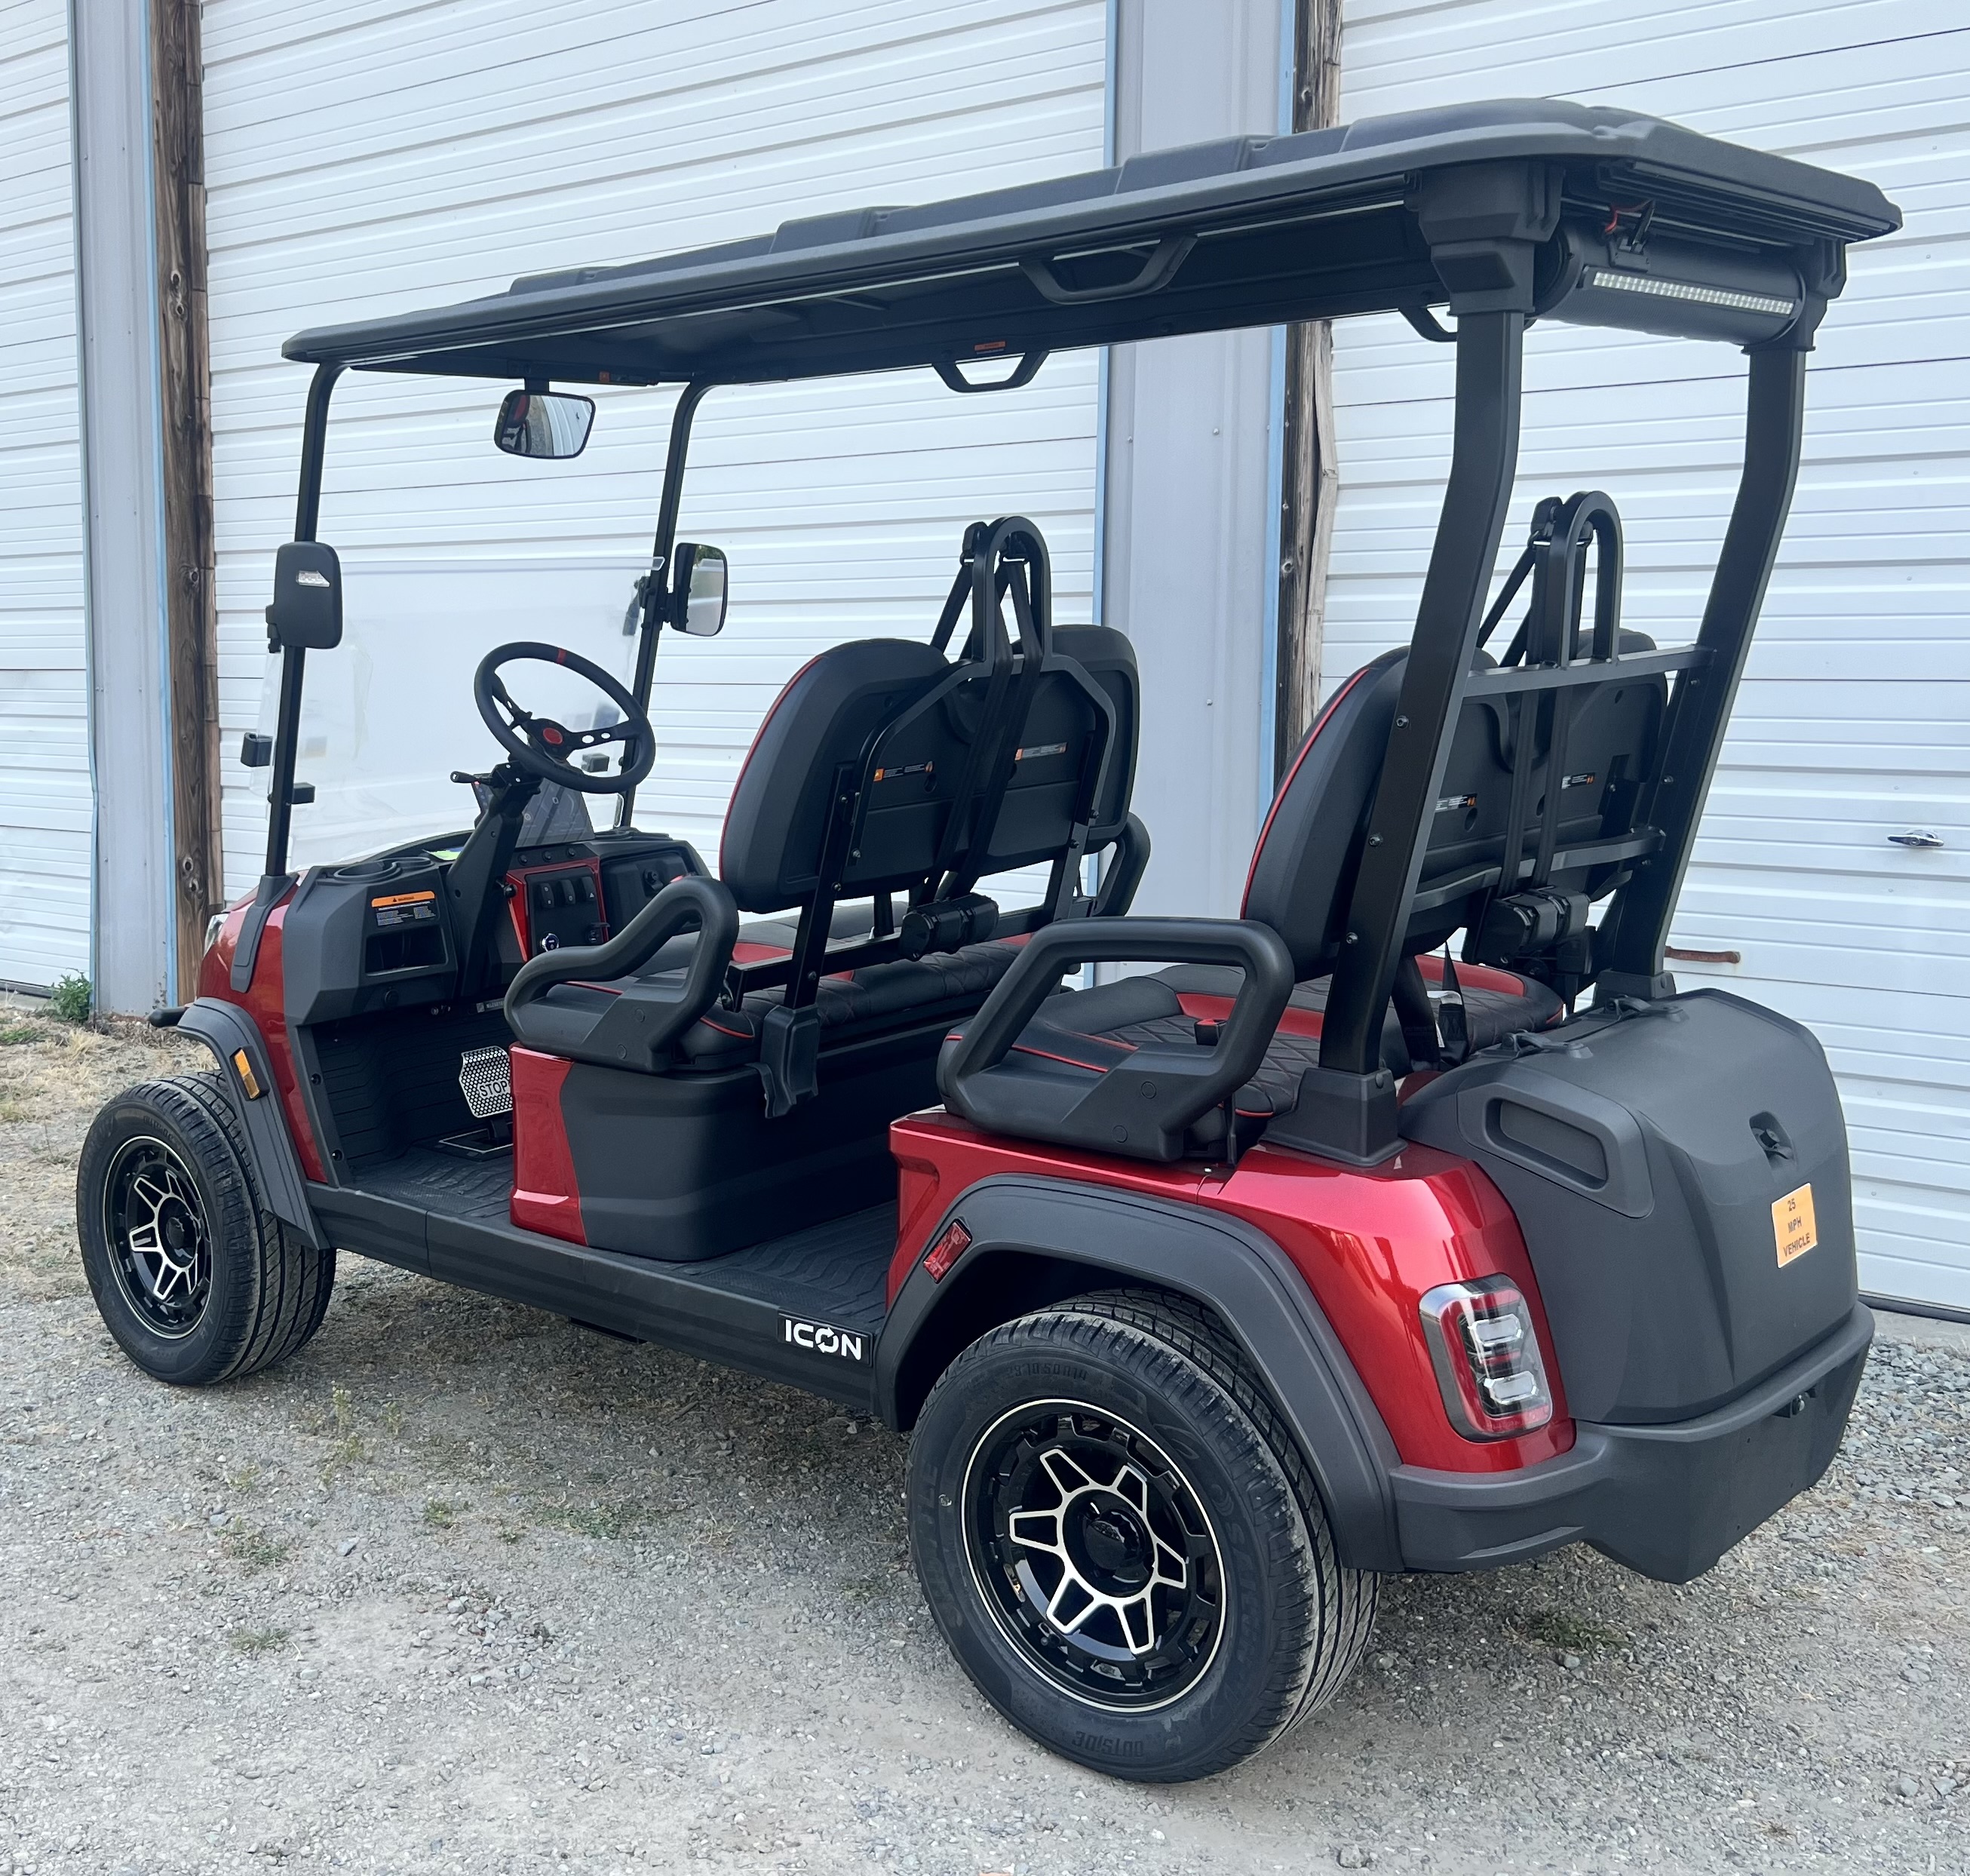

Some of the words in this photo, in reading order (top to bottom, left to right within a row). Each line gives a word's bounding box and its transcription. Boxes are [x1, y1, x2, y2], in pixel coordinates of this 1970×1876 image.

[1787, 1198, 1797, 1211] 25
[1787, 1216, 1803, 1233] MPH
[1782, 1233, 1811, 1257] VEHICLE
[785, 1319, 862, 1361] ICON
